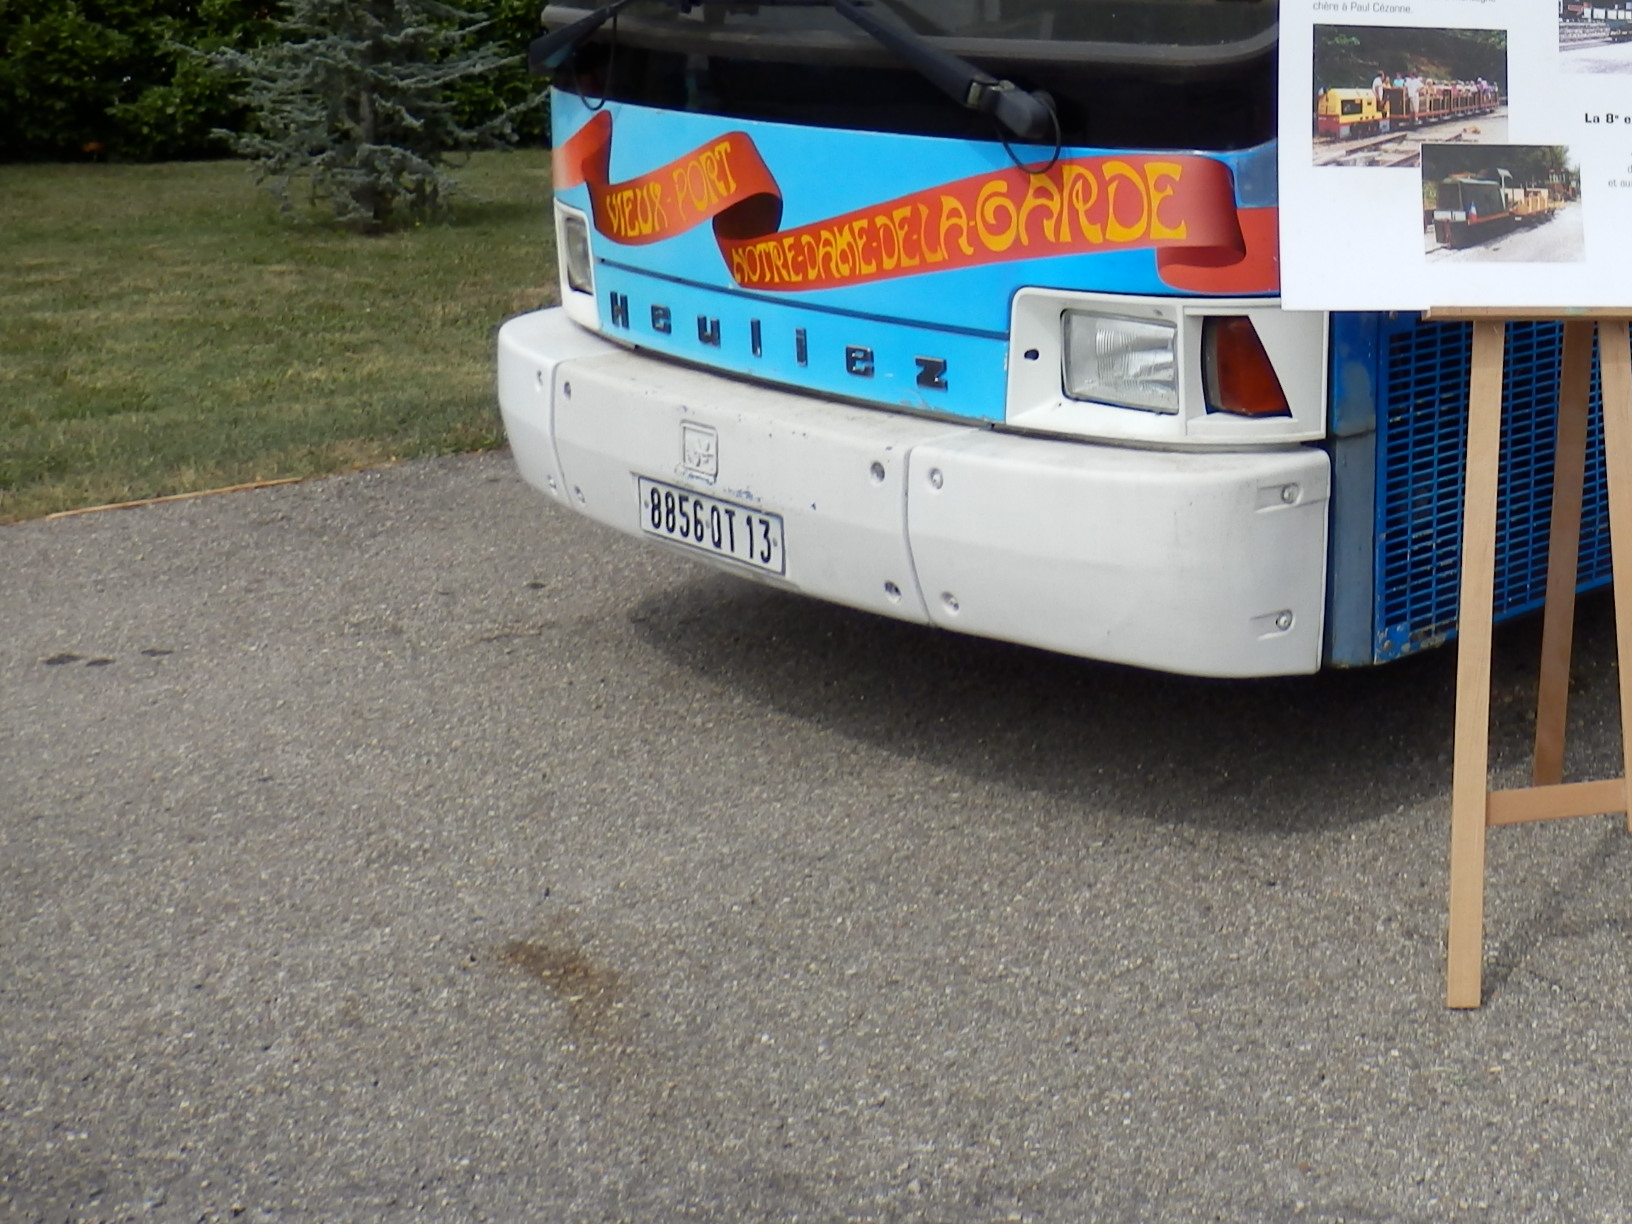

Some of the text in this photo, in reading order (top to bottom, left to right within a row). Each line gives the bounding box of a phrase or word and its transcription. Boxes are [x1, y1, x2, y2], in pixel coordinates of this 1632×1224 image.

[1313, 1, 1414, 14] chère à Paul Cézanne.
[1584, 113, 1600, 124] La
[1608, 179, 1618, 188] et
